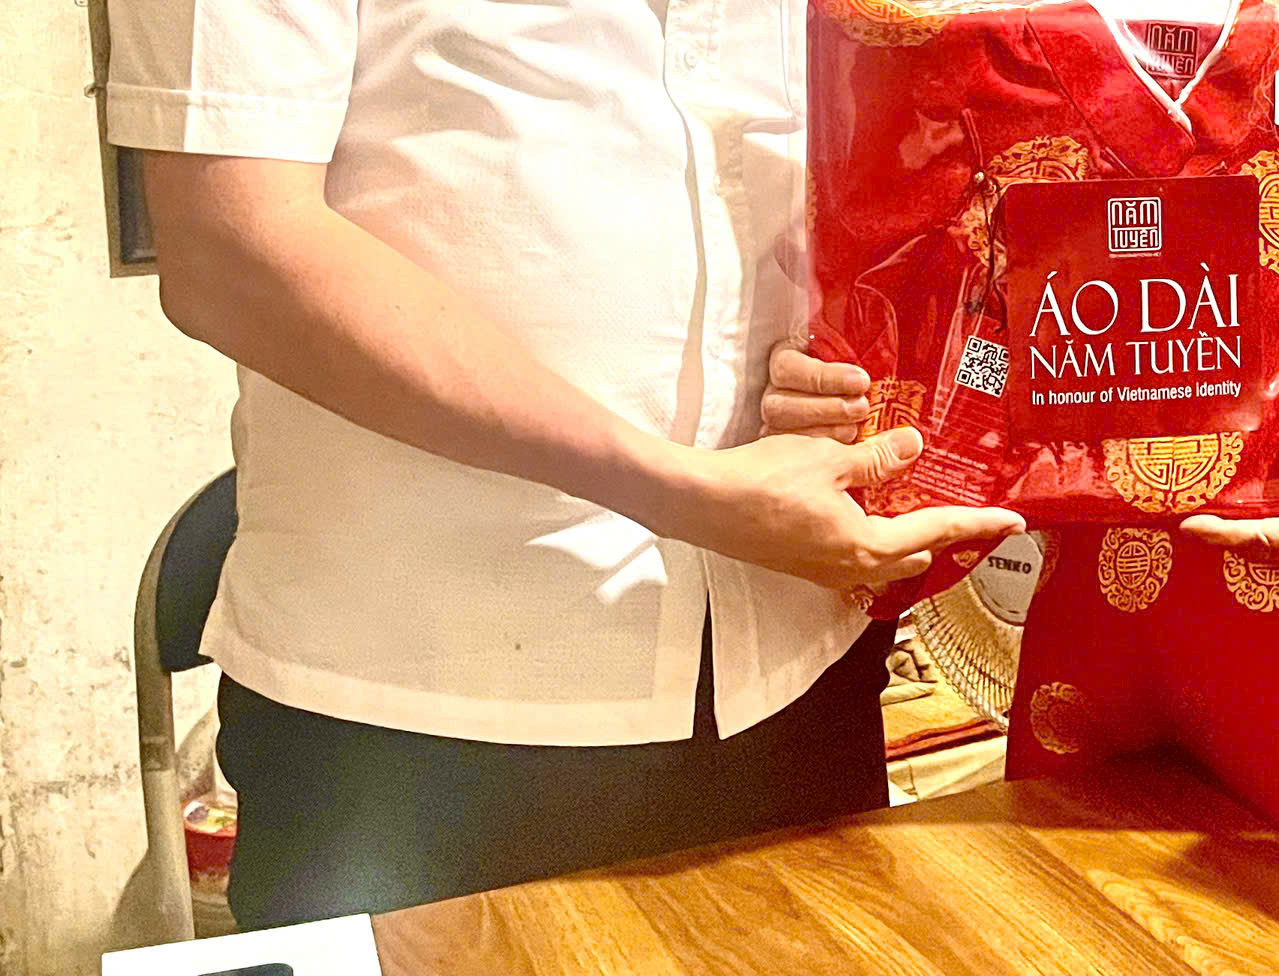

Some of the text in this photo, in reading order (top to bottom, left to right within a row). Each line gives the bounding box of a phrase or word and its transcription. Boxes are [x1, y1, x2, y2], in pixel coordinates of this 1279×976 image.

[1029, 261, 1241, 337] ÁO DÀI
[1029, 330, 1242, 380] NĂM TUYỀN
[1031, 389, 1045, 406] In
[1048, 388, 1096, 406] honour
[1099, 387, 1114, 403] of
[1116, 384, 1193, 403] Vietnamese
[987, 555, 1032, 575] SENKO
